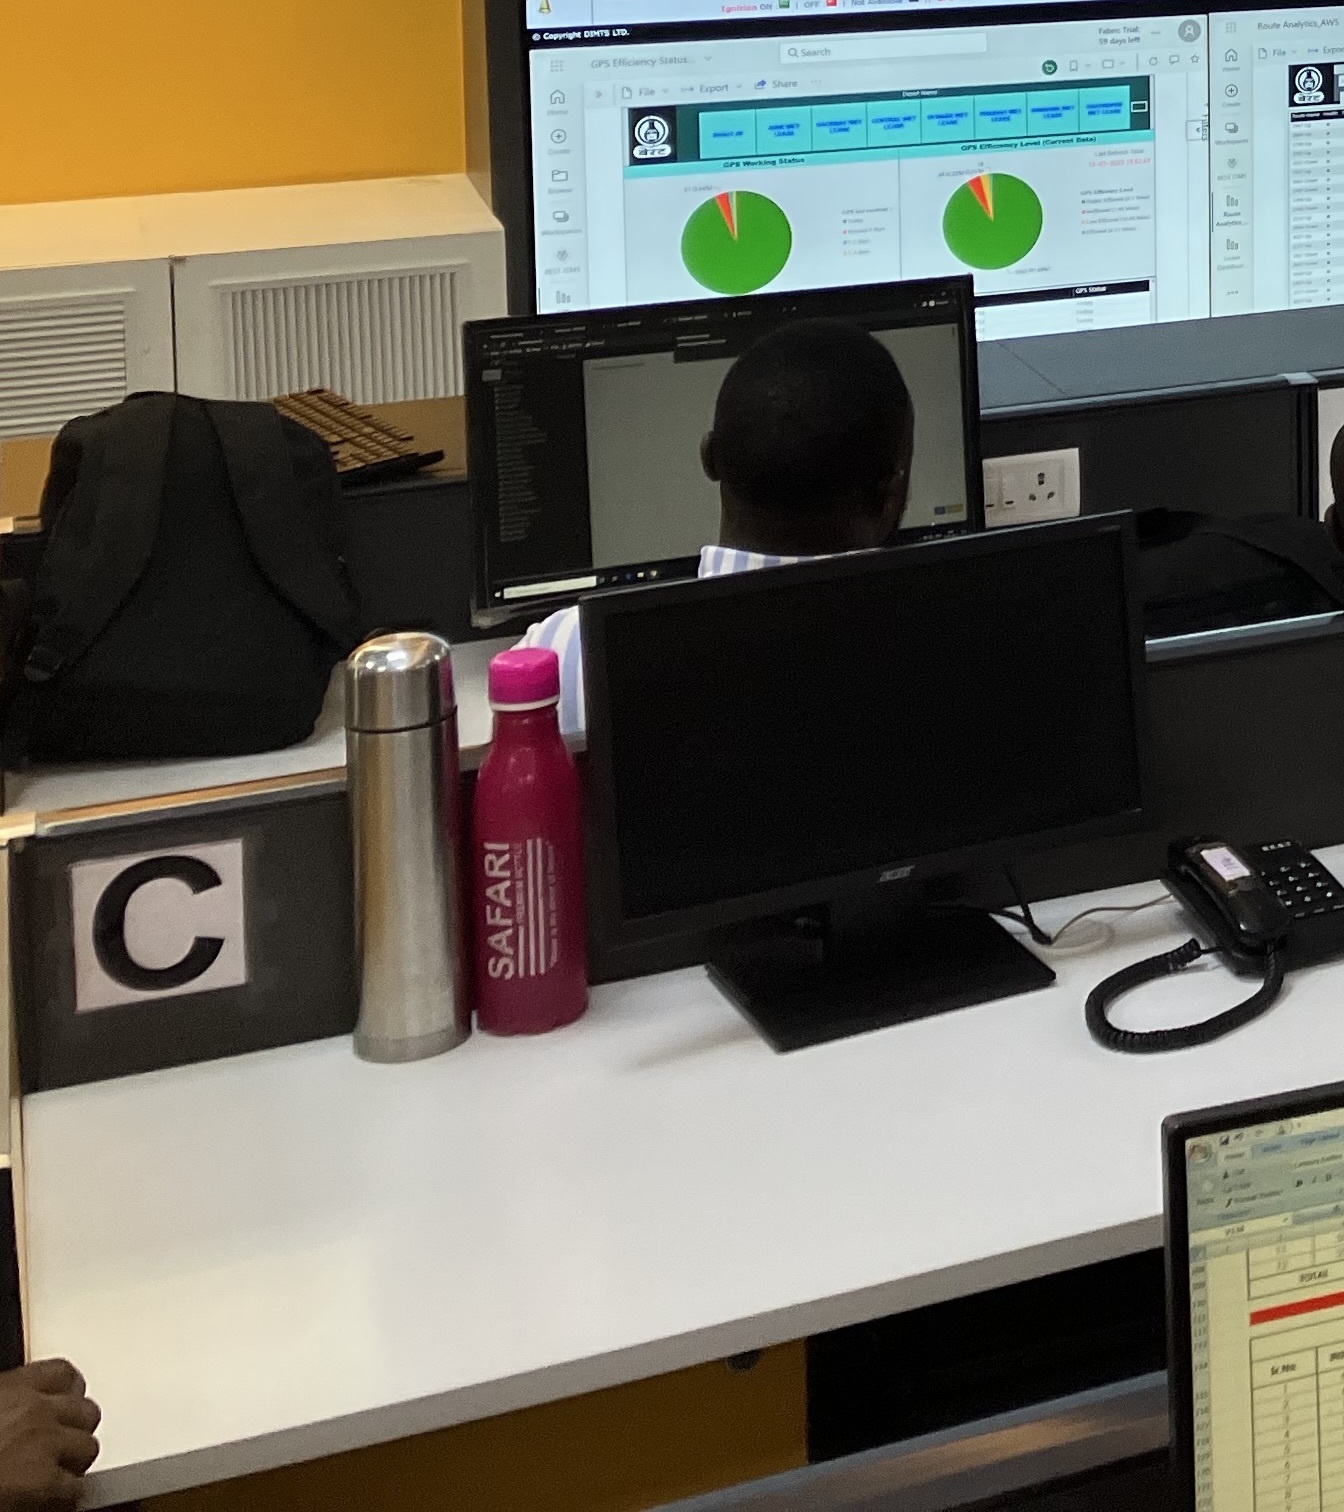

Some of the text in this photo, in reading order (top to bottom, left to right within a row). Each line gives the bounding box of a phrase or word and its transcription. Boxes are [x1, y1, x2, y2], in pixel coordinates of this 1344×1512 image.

[721, 3, 773, 14] Ignition ON
[1258, 18, 1340, 31] Route Analytics_AWS
[543, 31, 582, 42] Copyright
[584, 30, 611, 39] DIMTS
[612, 28, 630, 38] LTD.
[800, 46, 832, 58] Search
[1272, 48, 1287, 57] File
[700, 84, 729, 95] Export
[772, 79, 798, 89] Share
[638, 88, 656, 97] File
[722, 157, 805, 169] GPS Working Status
[484, 842, 515, 980] SAFARI
[93, 855, 225, 991] C
